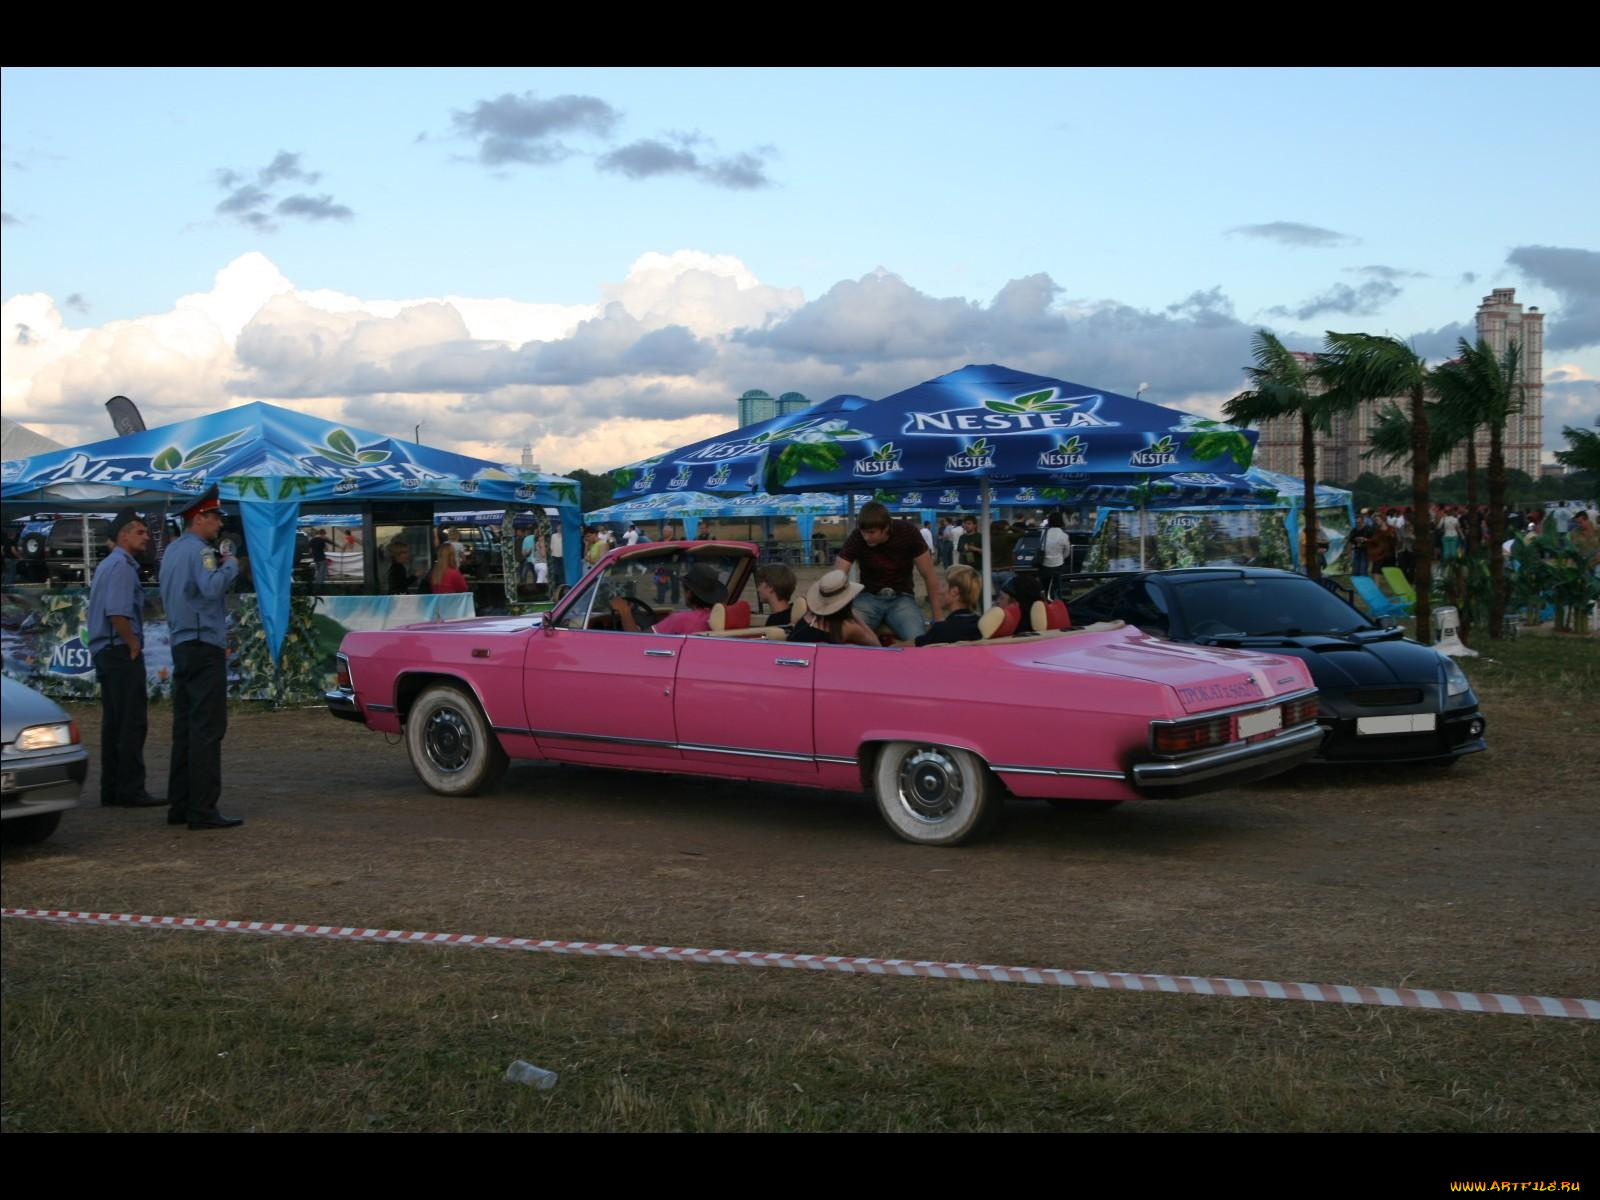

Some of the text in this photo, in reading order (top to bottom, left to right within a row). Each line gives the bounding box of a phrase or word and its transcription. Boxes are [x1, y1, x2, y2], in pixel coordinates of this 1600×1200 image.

[911, 411, 1100, 431] NESTEA
[947, 455, 993, 468] NESTEA
[1039, 453, 1085, 466] NESTEA
[1132, 450, 1177, 465] NESTEA
[855, 459, 901, 473] NESTEA
[52, 645, 91, 668] NEST
